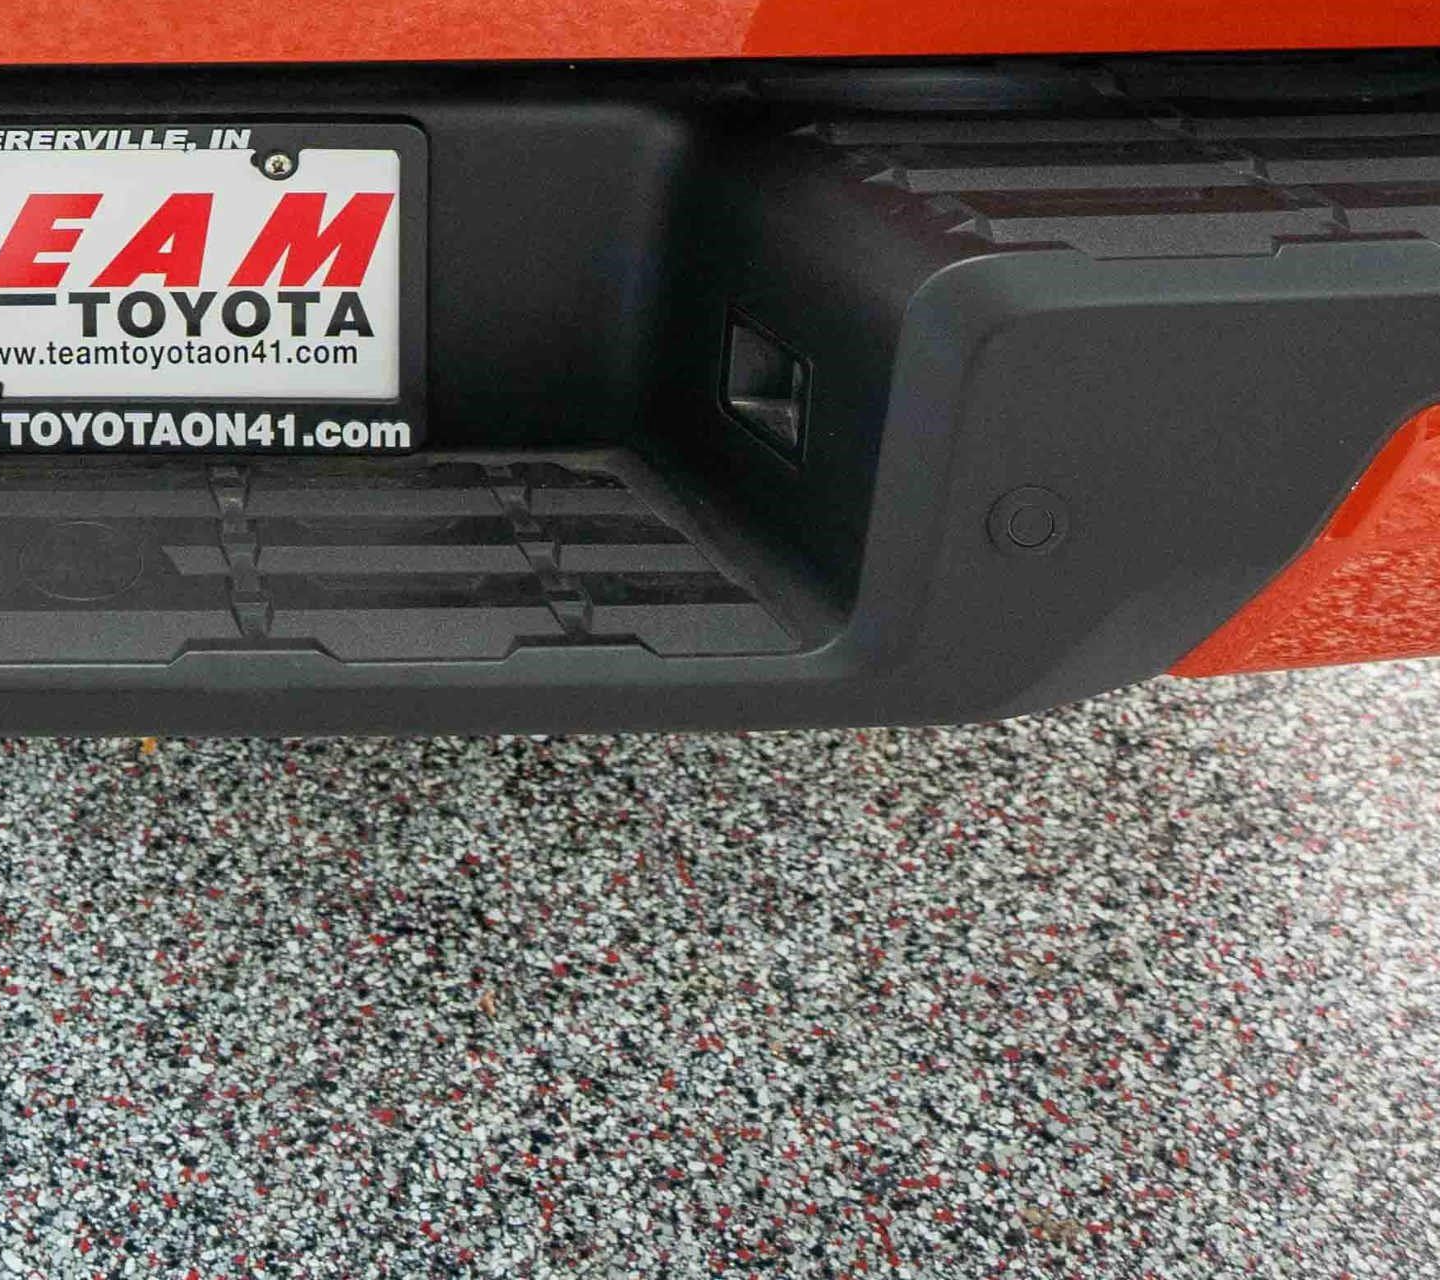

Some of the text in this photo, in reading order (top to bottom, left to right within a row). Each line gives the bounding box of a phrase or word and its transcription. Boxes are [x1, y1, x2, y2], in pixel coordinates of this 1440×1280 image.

[208, 128, 252, 150] IN
[68, 290, 375, 339] TOYOTA
[0, 410, 411, 449] TOYOTAON41.com
